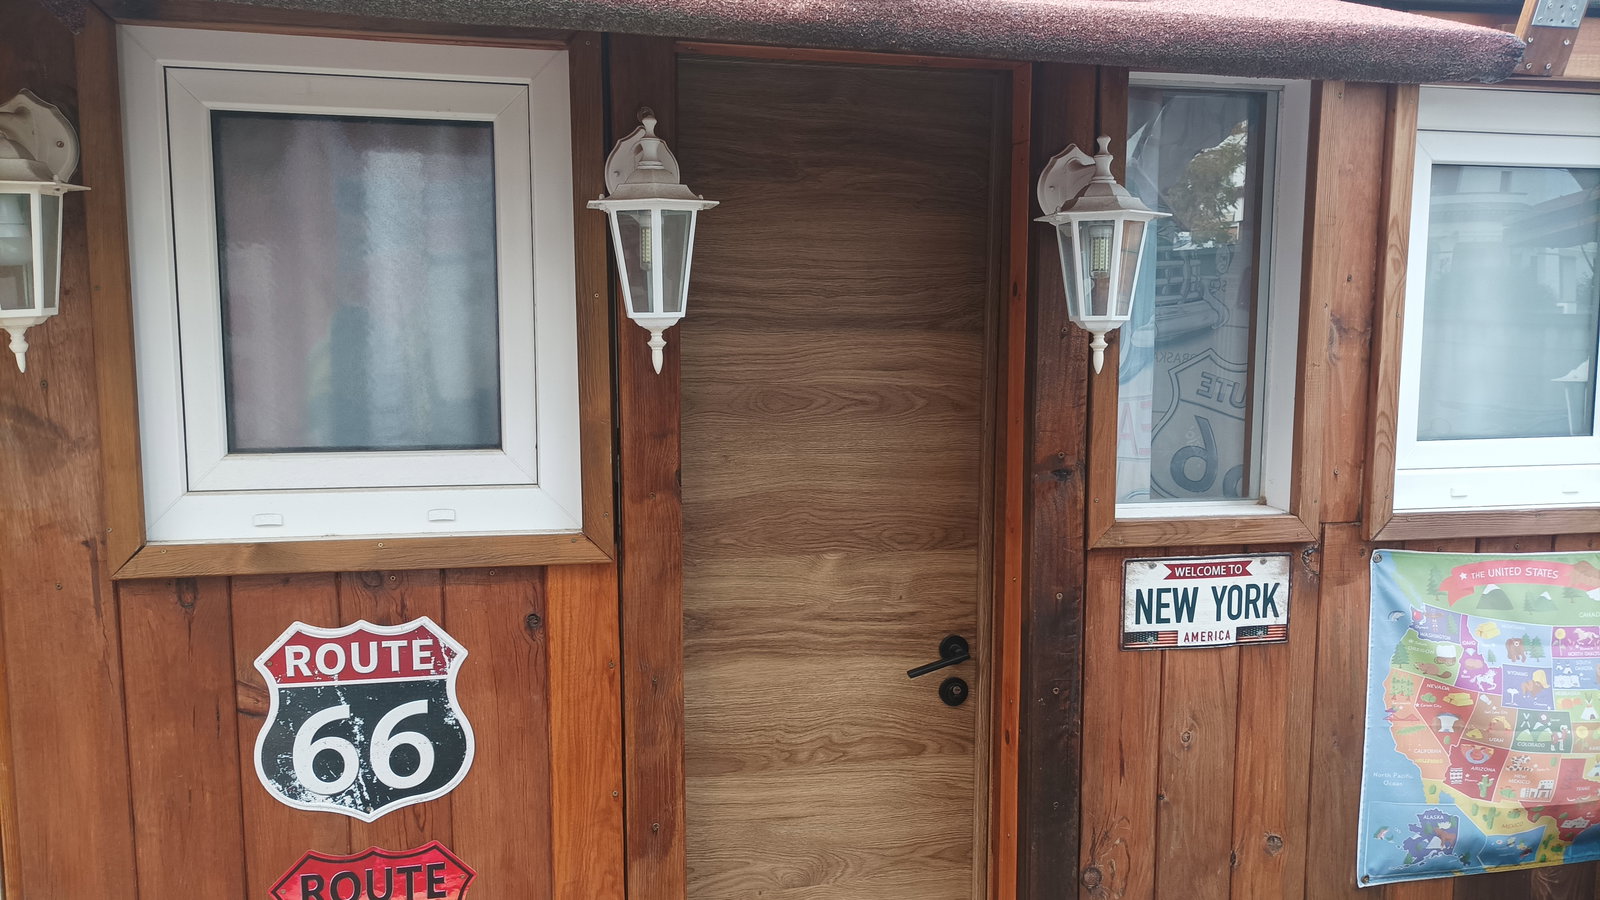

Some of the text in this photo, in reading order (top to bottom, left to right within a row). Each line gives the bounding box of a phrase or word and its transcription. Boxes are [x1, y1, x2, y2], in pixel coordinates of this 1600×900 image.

[1174, 564, 1243, 577] WELCOME TO
[1471, 567, 1559, 580] THE UNITED STATES
[1135, 582, 1280, 625] NEW YORK
[1183, 630, 1231, 643] AMERICA
[285, 639, 434, 678] ROUTE
[1426, 683, 1450, 691] NEVADA
[293, 700, 435, 796] 66
[300, 861, 448, 900] ROUTE
